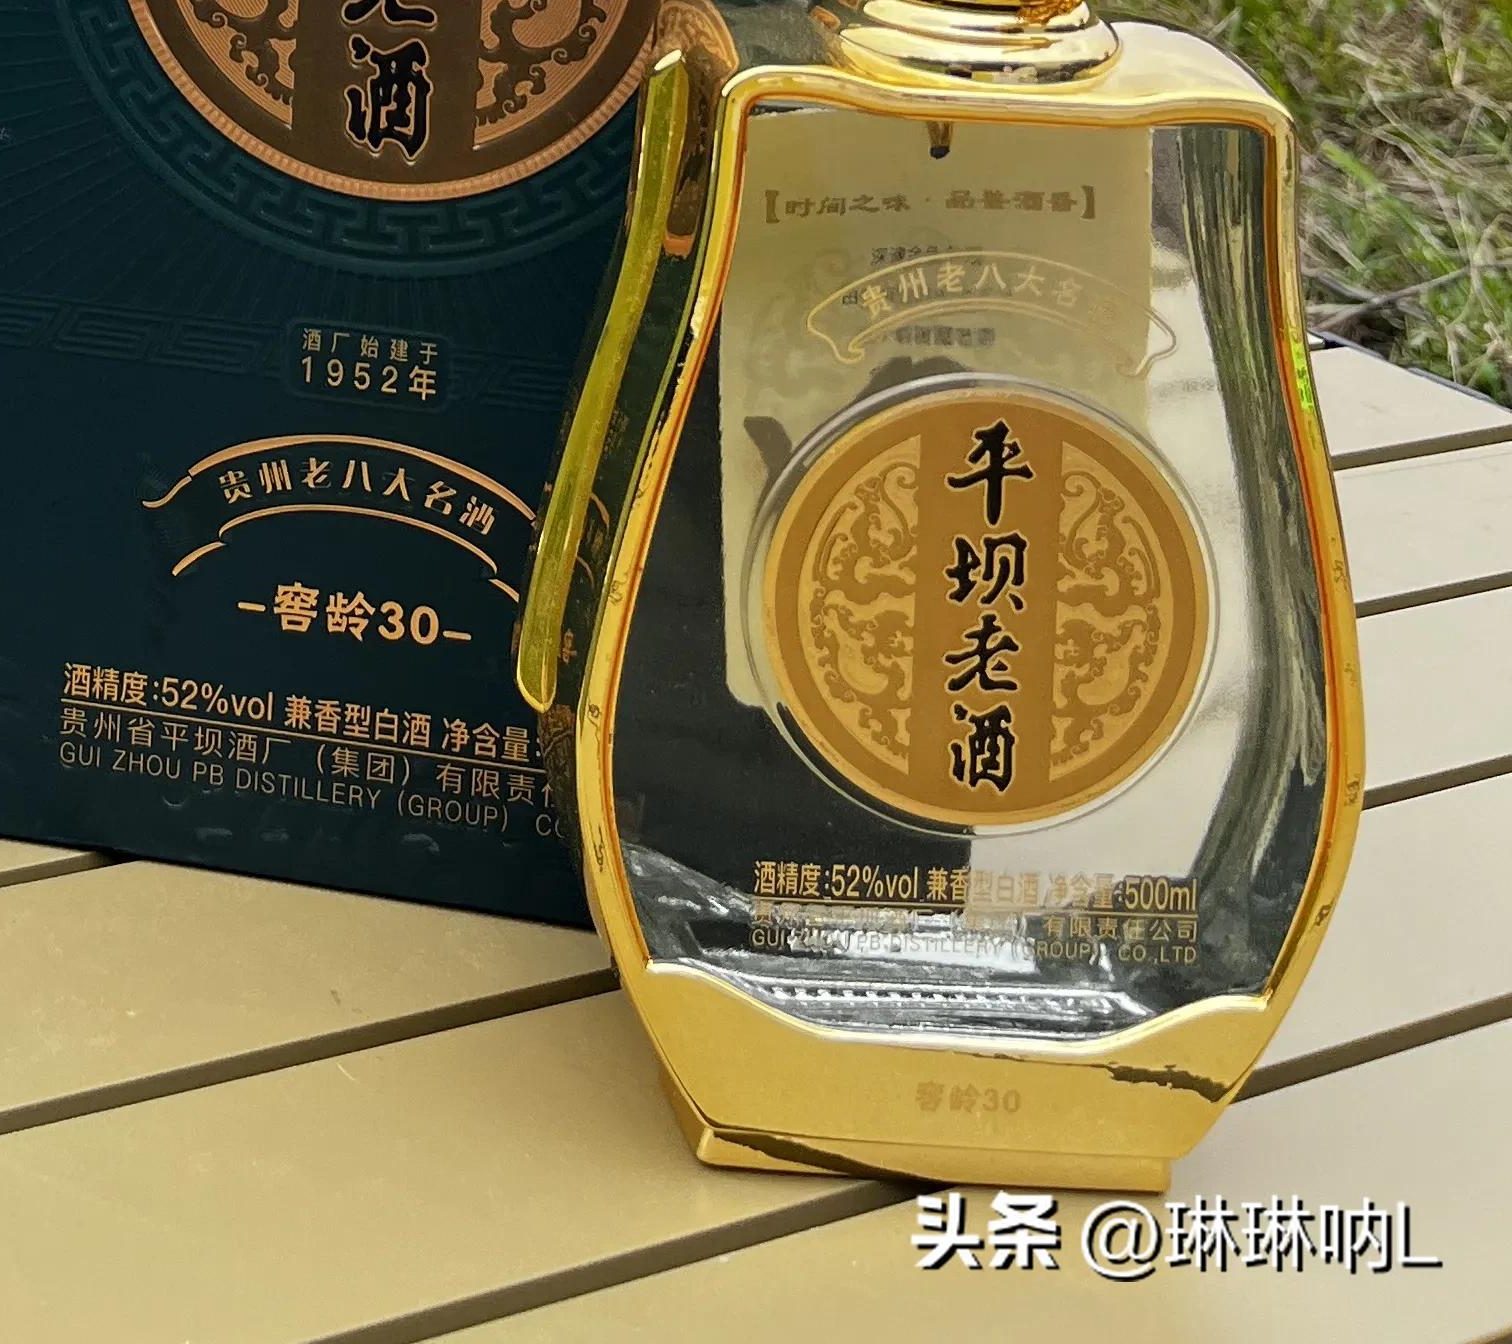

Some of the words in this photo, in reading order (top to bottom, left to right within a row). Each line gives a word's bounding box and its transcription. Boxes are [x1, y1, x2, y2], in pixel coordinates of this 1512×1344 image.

[301, 328, 439, 365] 酒厂始建于
[301, 357, 438, 401] 1952年
[943, 418, 1035, 793] 平坝老酒
[62, 661, 274, 722] 酒精度:52%vol
[284, 695, 431, 749] 兼香型白酒
[59, 741, 101, 768] GUI
[112, 749, 181, 781] ZHOU
[192, 761, 225, 787] PB
[235, 769, 381, 810] DISTILLERY
[397, 790, 509, 833] (GROUP)
[753, 859, 919, 899] 酒精度:52%vol
[926, 866, 1040, 905] 兼香型白酒
[752, 928, 786, 948] GUI
